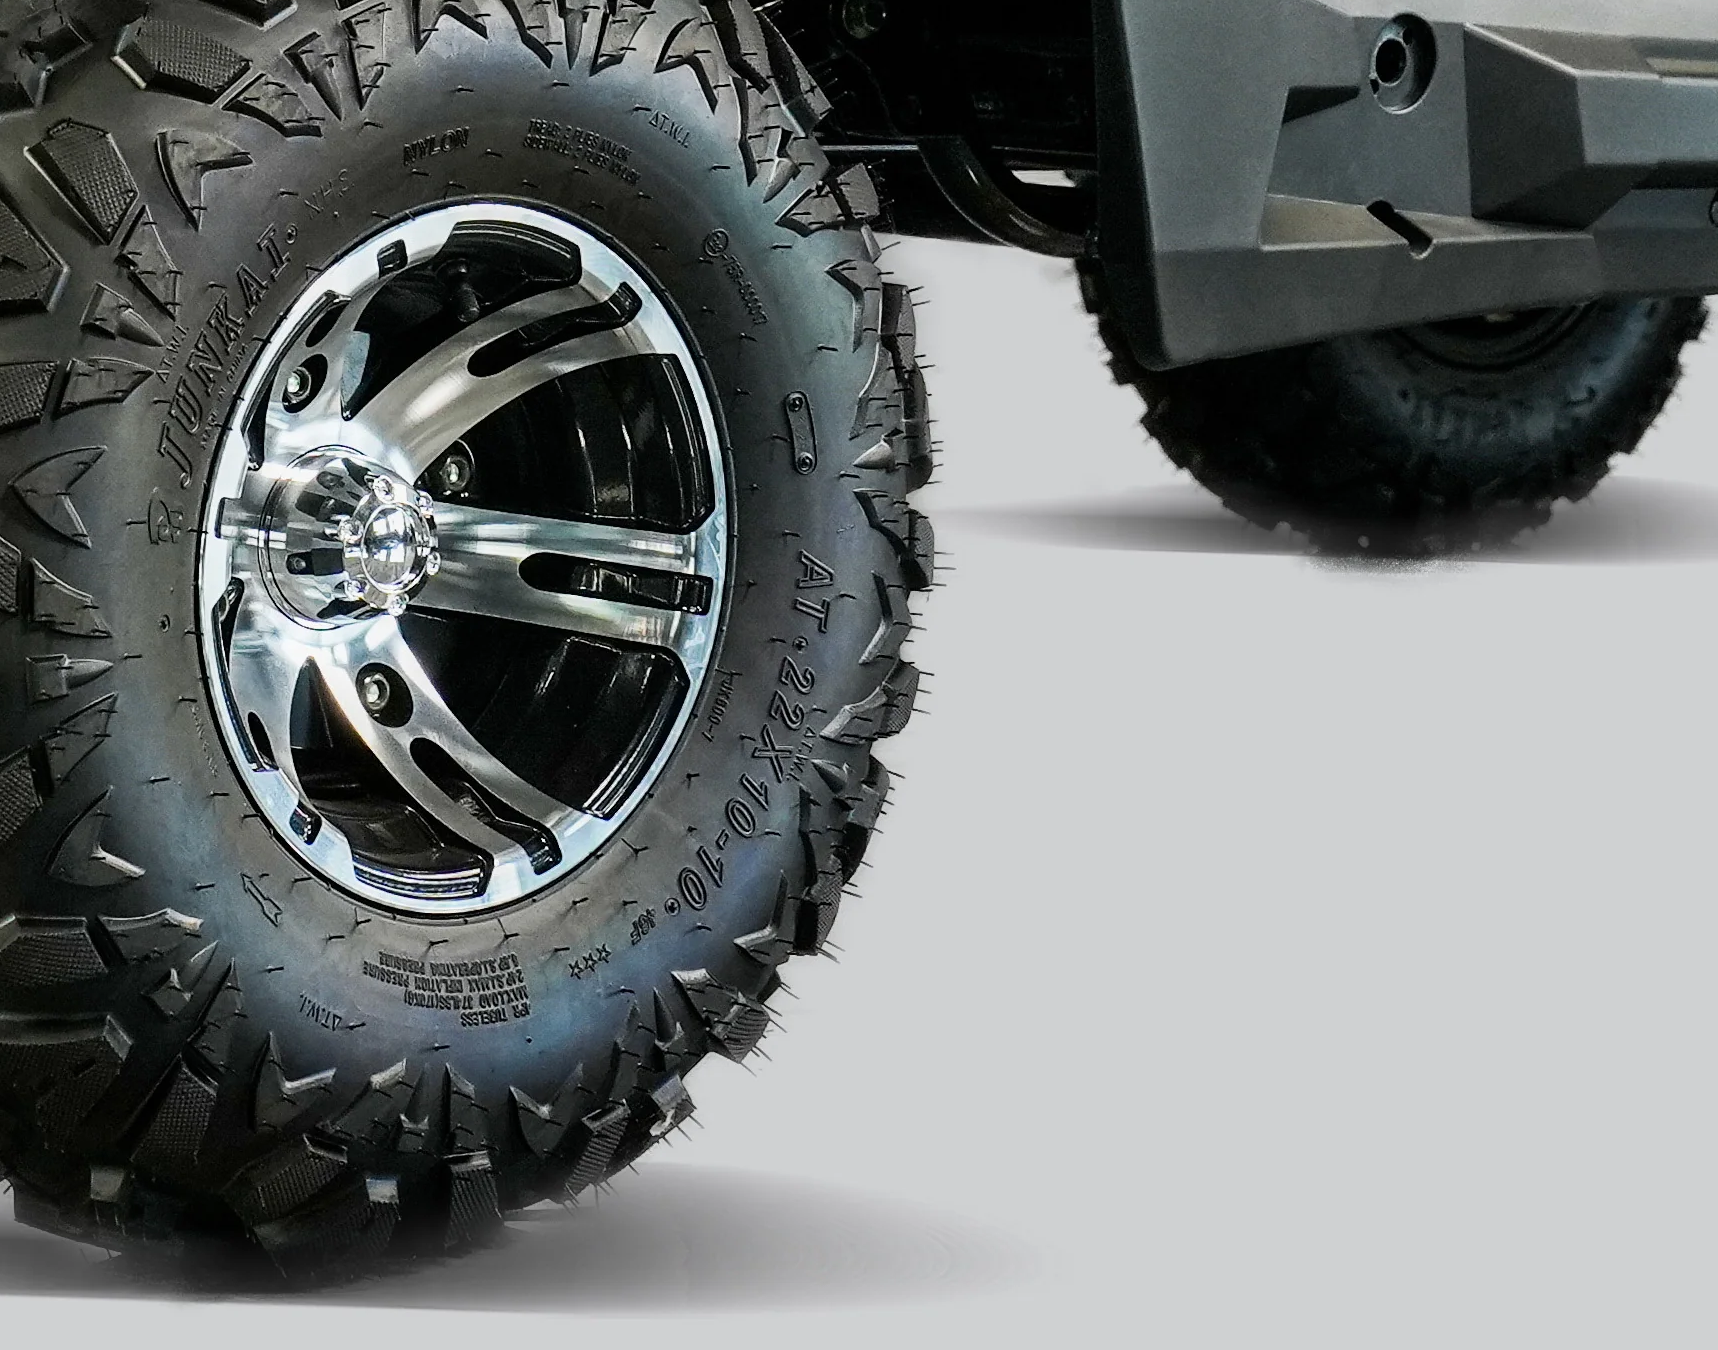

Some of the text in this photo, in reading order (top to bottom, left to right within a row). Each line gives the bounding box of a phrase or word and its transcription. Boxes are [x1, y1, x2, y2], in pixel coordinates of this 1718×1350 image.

[402, 128, 469, 167] NYLON
[157, 223, 290, 488] JUNKAI
[794, 549, 835, 634] AT
[362, 959, 410, 988] PRESSURE
